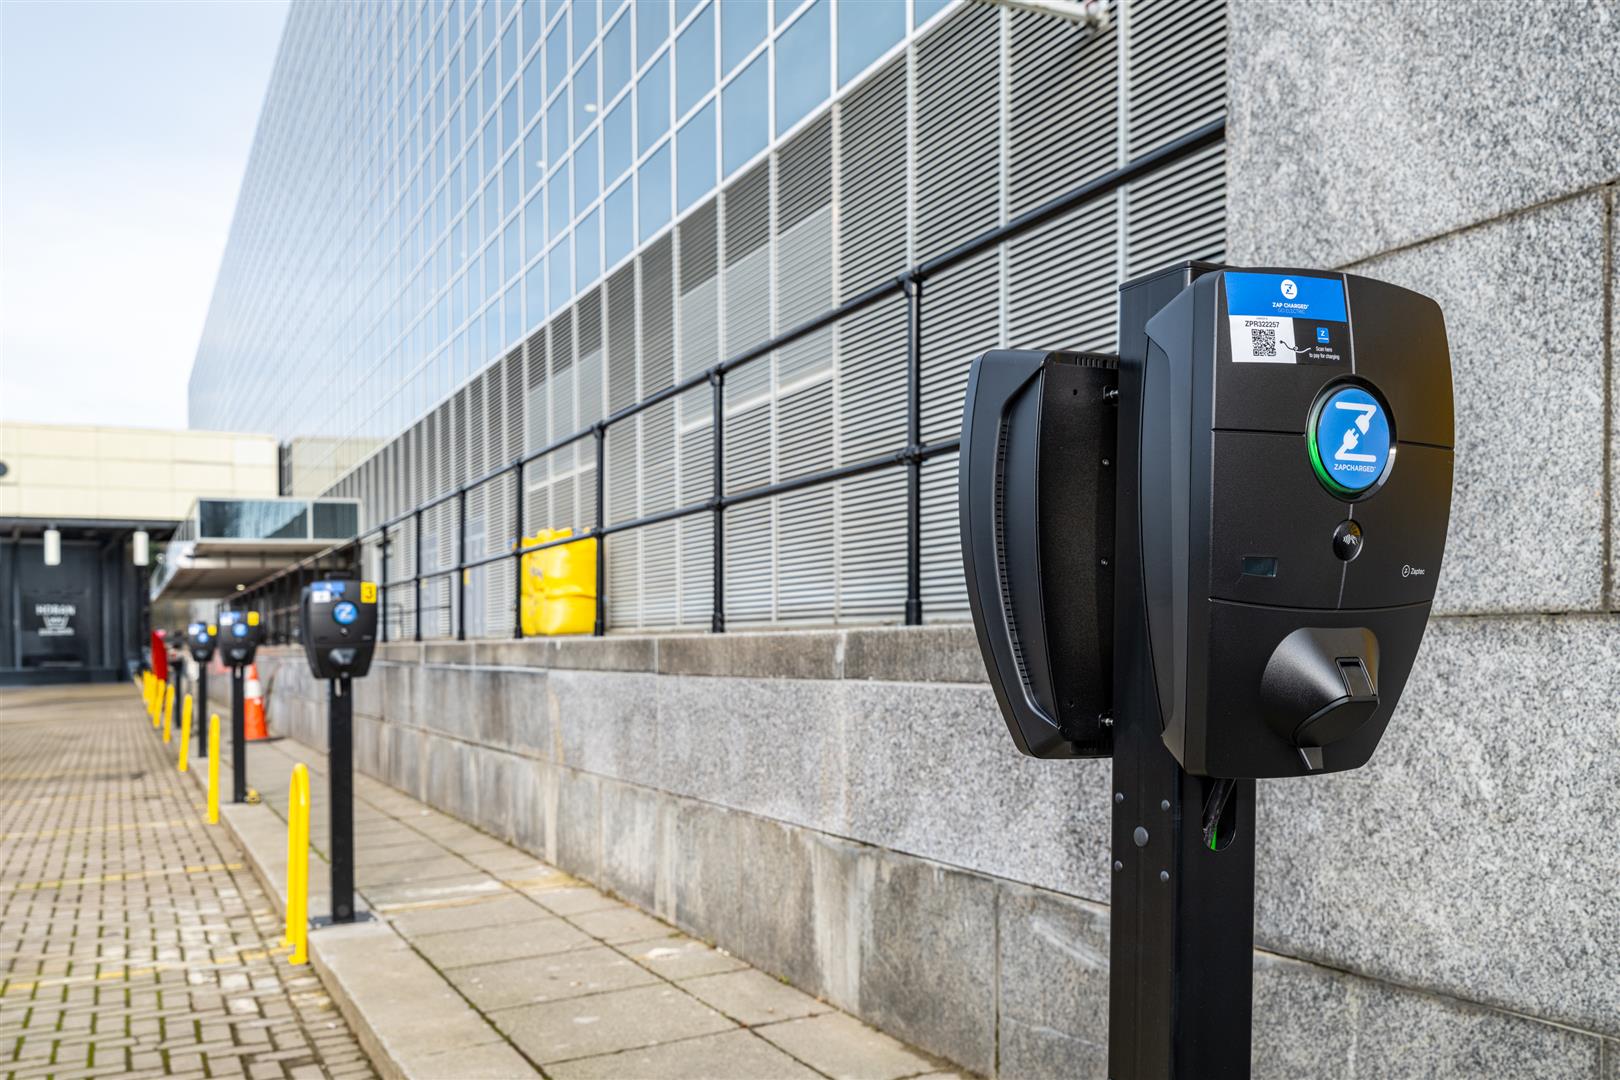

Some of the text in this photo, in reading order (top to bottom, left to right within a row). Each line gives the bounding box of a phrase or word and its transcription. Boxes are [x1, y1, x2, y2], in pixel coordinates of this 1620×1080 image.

[1245, 320, 1280, 328] ZPR322257
[1410, 567, 1425, 576] Zaptec
[364, 585, 374, 600] 3
